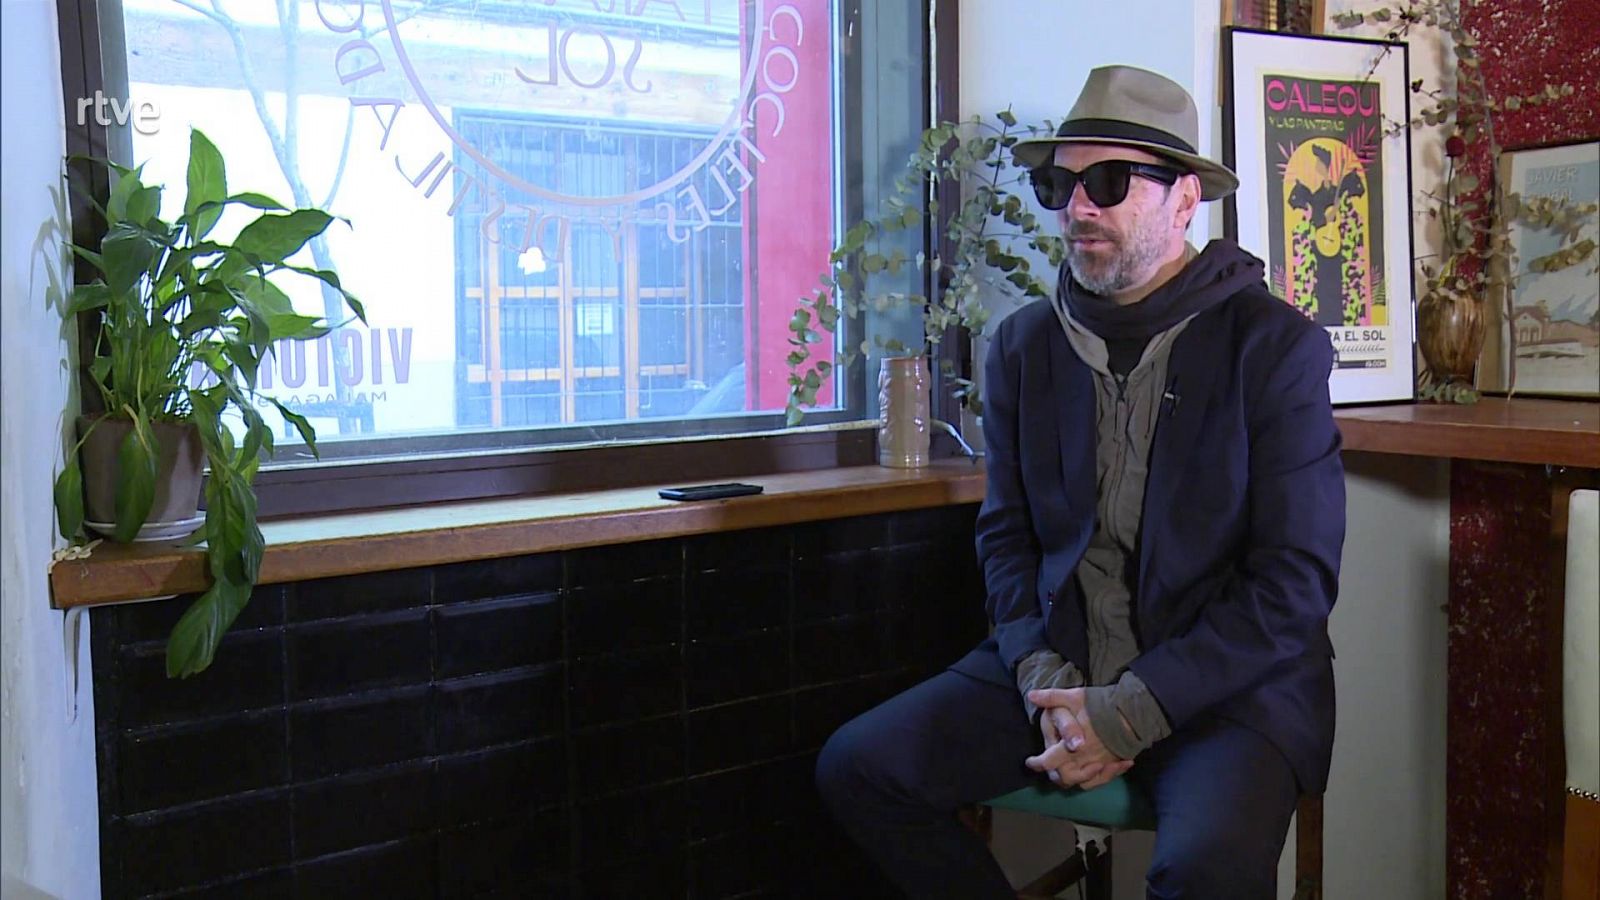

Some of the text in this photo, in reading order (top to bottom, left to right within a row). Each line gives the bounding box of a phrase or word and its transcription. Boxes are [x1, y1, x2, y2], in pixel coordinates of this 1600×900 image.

[1266, 79, 1379, 118] CALEQUI
[1276, 116, 1296, 129] LAS
[1296, 117, 1345, 132] PANTERAS
[1345, 330, 1359, 341] EL
[1362, 329, 1386, 341] SOL
